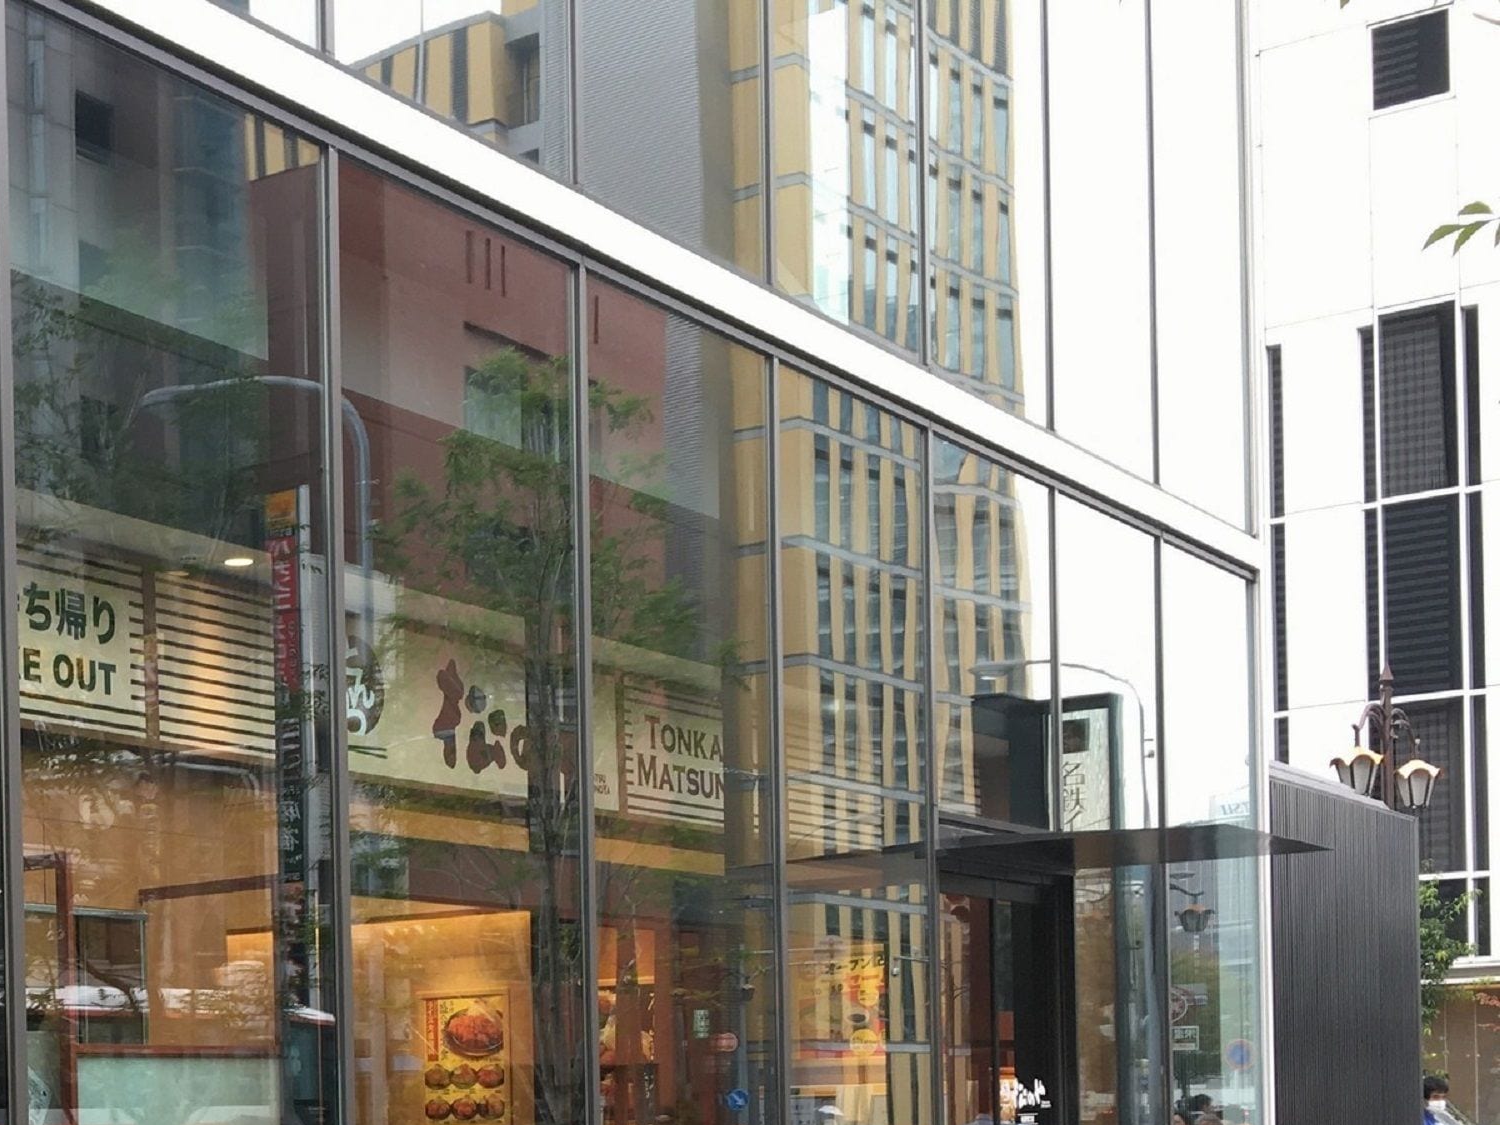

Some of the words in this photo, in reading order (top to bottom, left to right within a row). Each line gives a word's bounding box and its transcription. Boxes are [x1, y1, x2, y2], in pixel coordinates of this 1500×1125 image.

[17, 581, 116, 645] ち帰り
[53, 653, 117, 696] OUT
